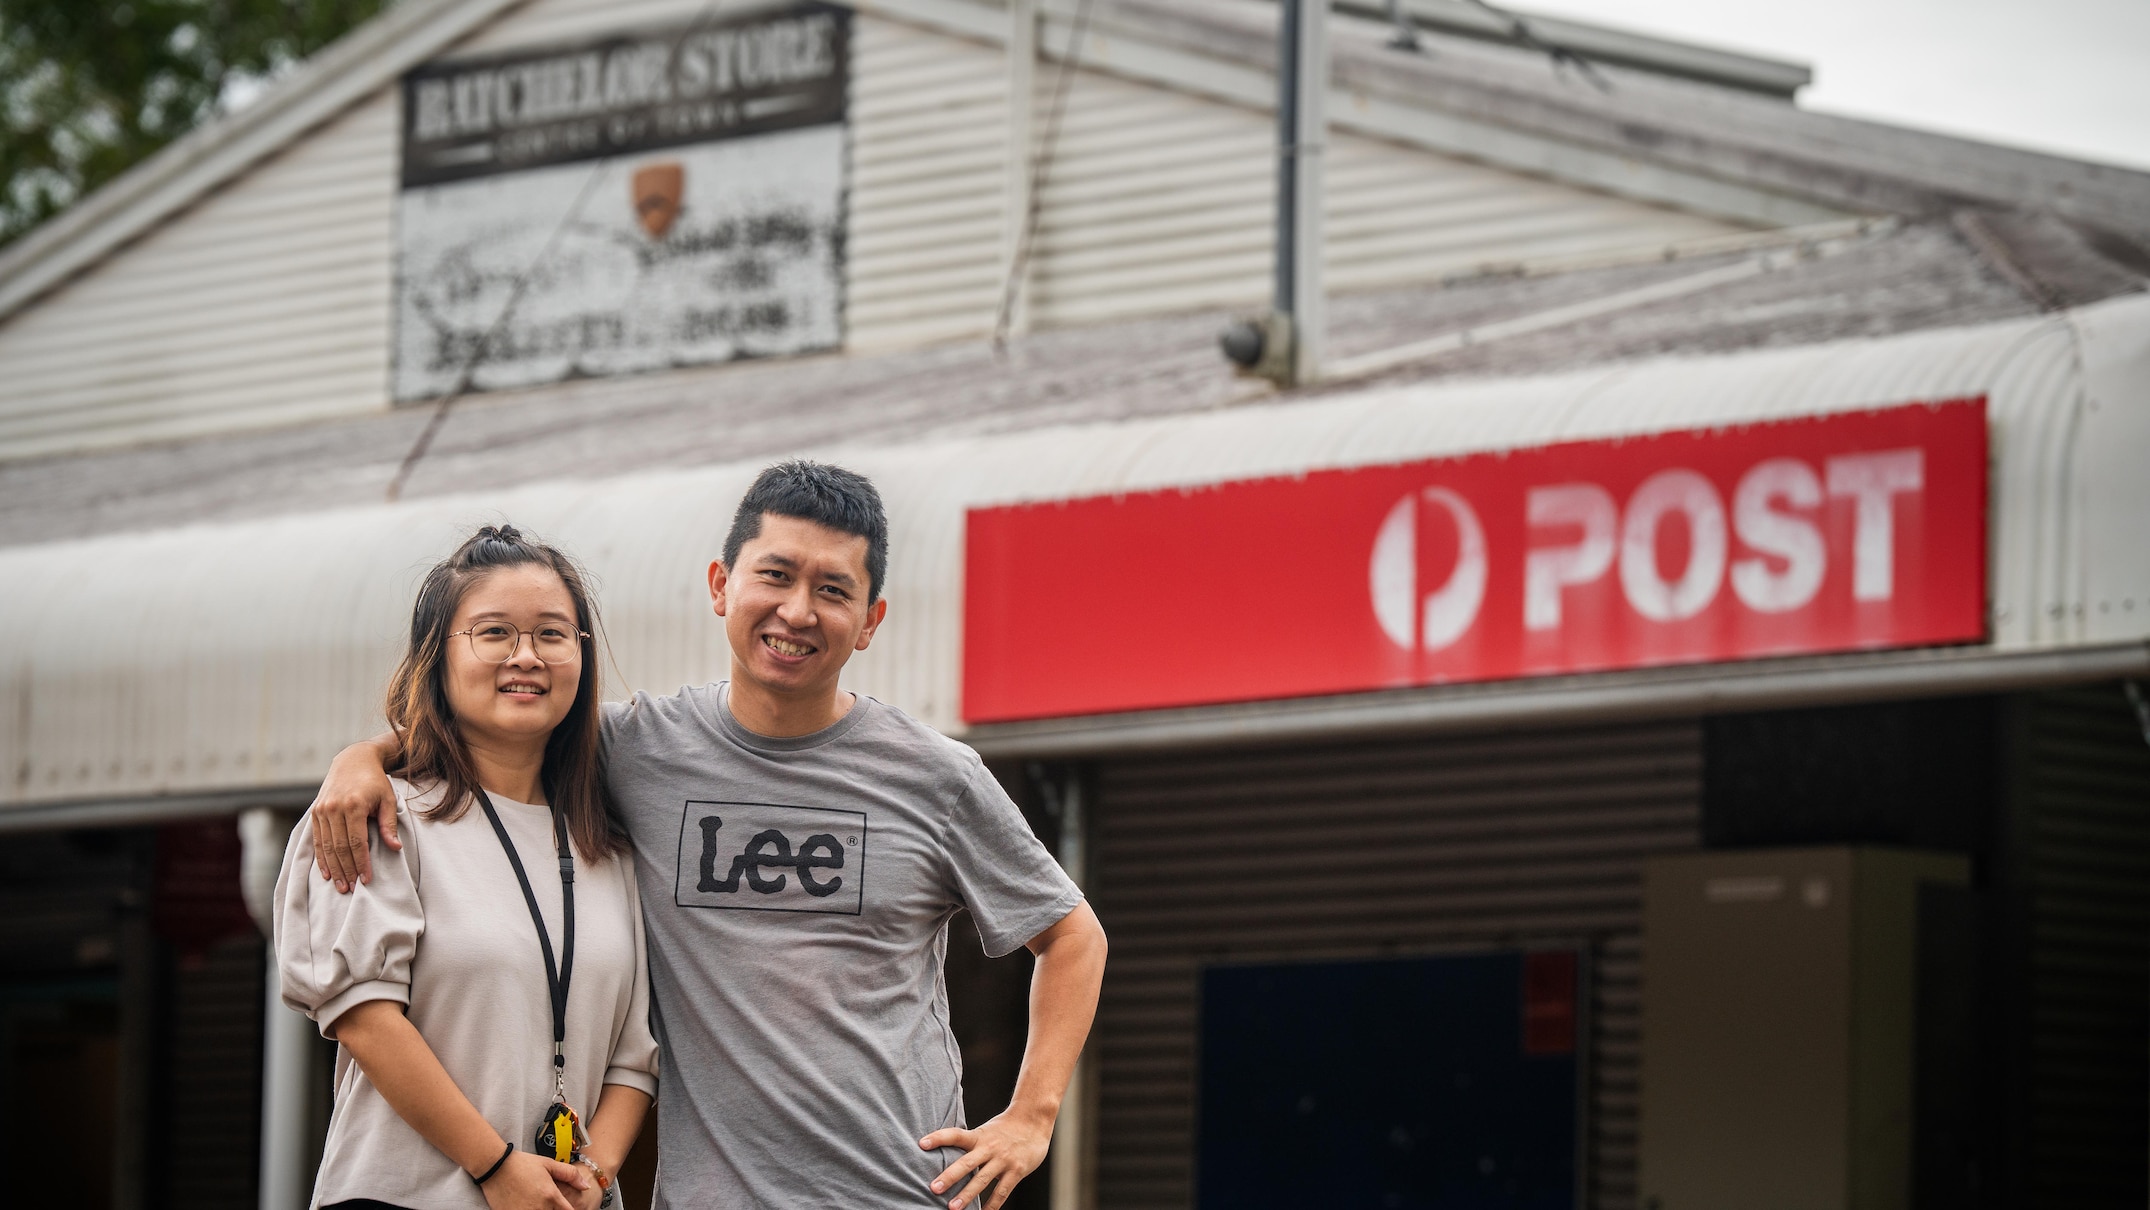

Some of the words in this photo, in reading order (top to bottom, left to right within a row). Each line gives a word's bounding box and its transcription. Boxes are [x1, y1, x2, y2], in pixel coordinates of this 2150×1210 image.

[413, 42, 672, 141] BATCHELOR
[680, 13, 838, 95] STORE
[1524, 448, 1924, 631] POST
[697, 816, 845, 897] Lee
